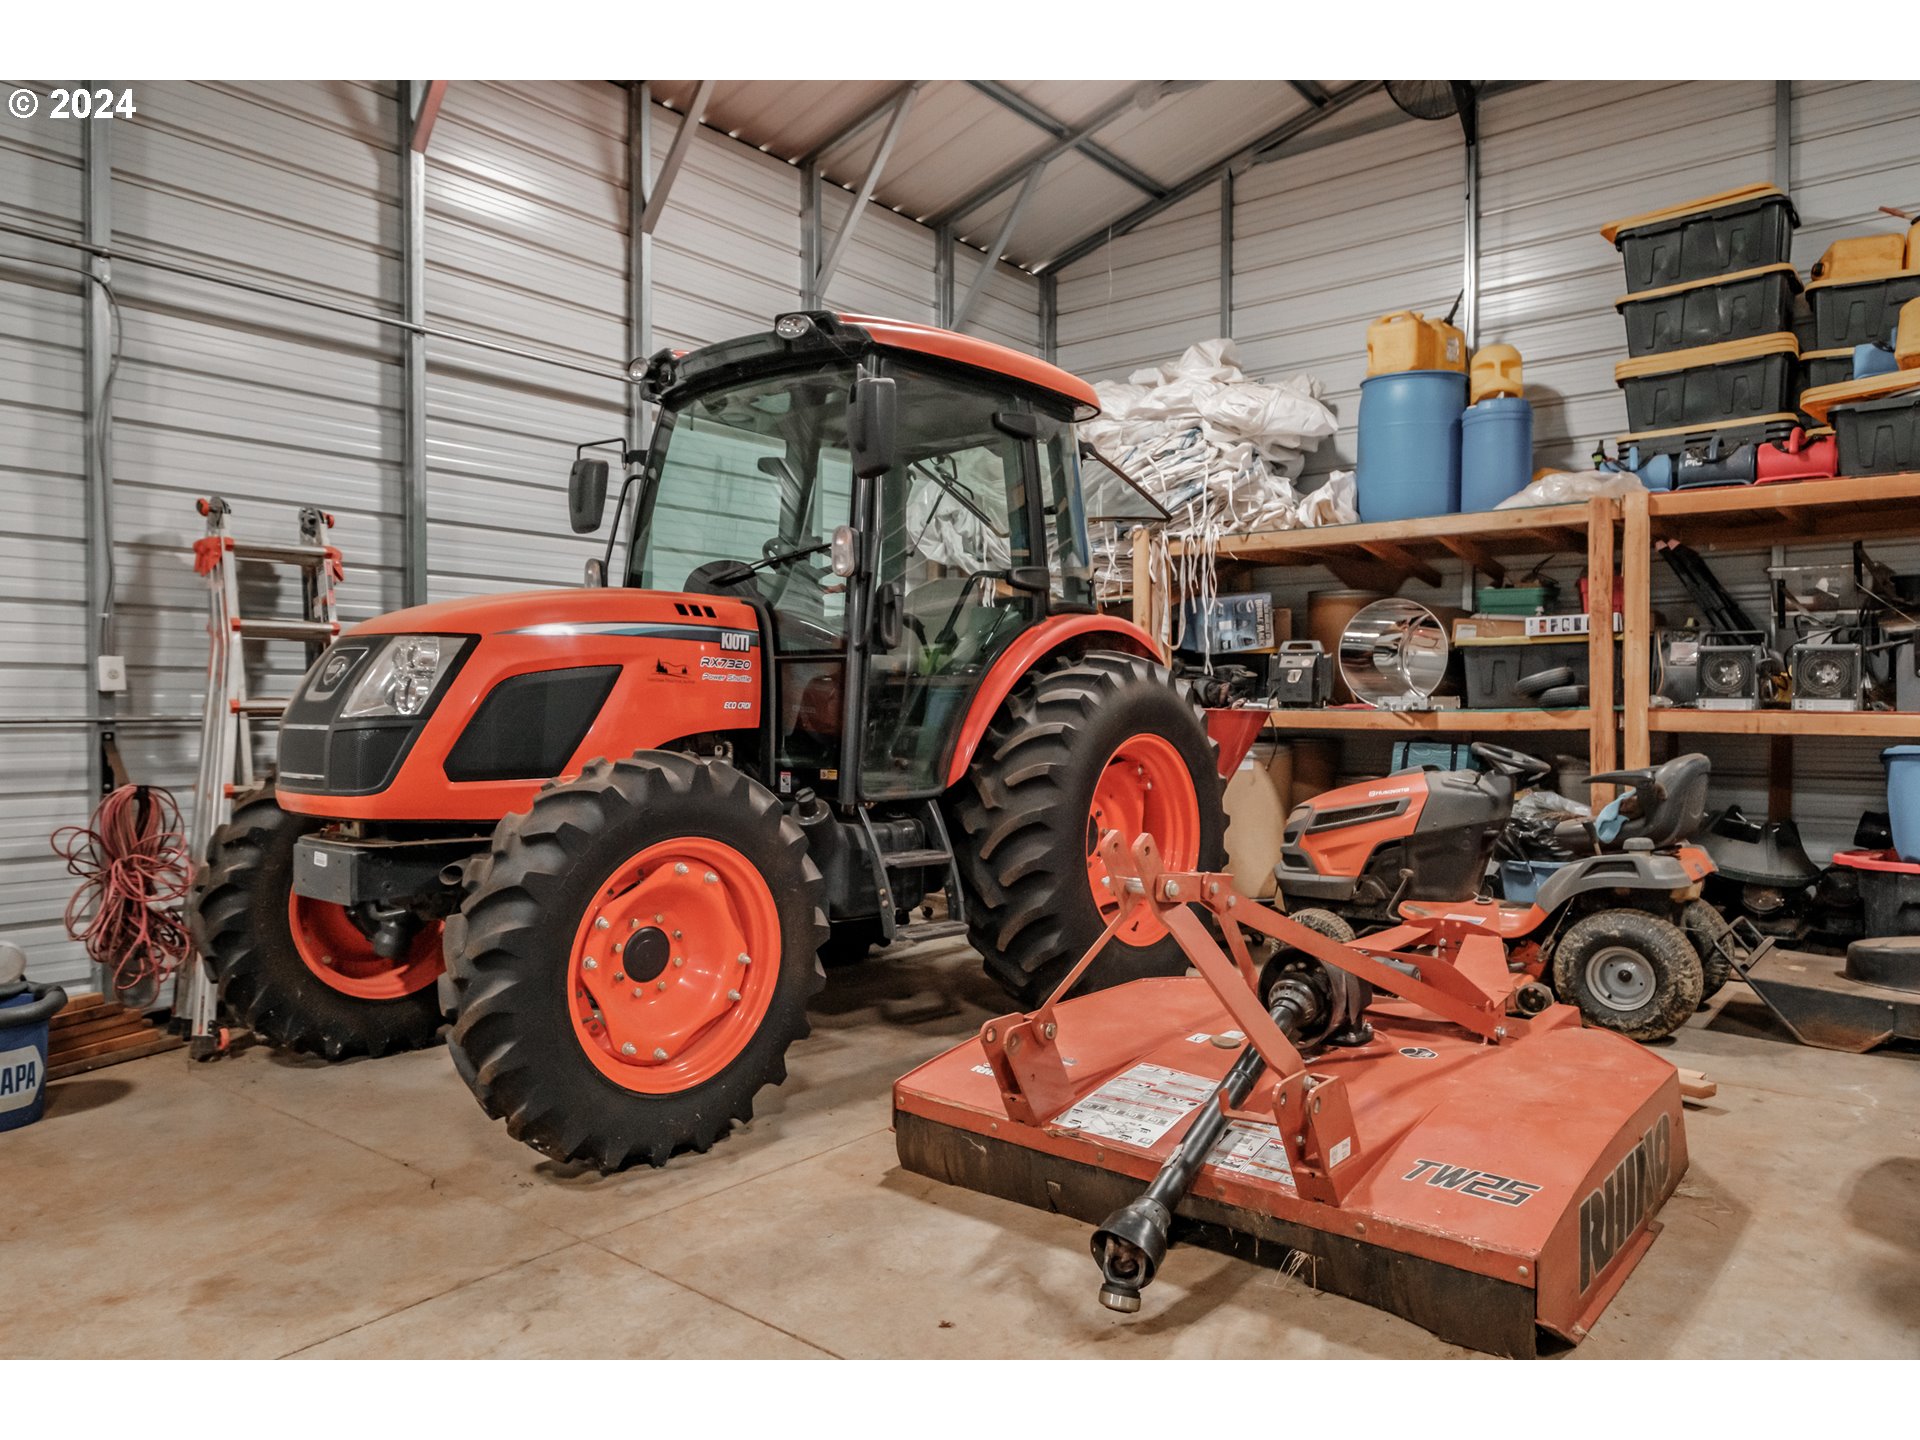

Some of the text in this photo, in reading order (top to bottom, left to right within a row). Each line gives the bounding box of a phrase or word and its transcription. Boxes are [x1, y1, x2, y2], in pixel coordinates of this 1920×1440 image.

[721, 632, 750, 652] KIOTI
[700, 656, 751, 670] RX7320
[702, 673, 752, 683] Power Shuttle
[723, 701, 736, 710] ECO
[0, 1061, 36, 1096] APA
[1401, 1158, 1544, 1207] TW25
[1579, 1112, 1671, 1298] RHINO
